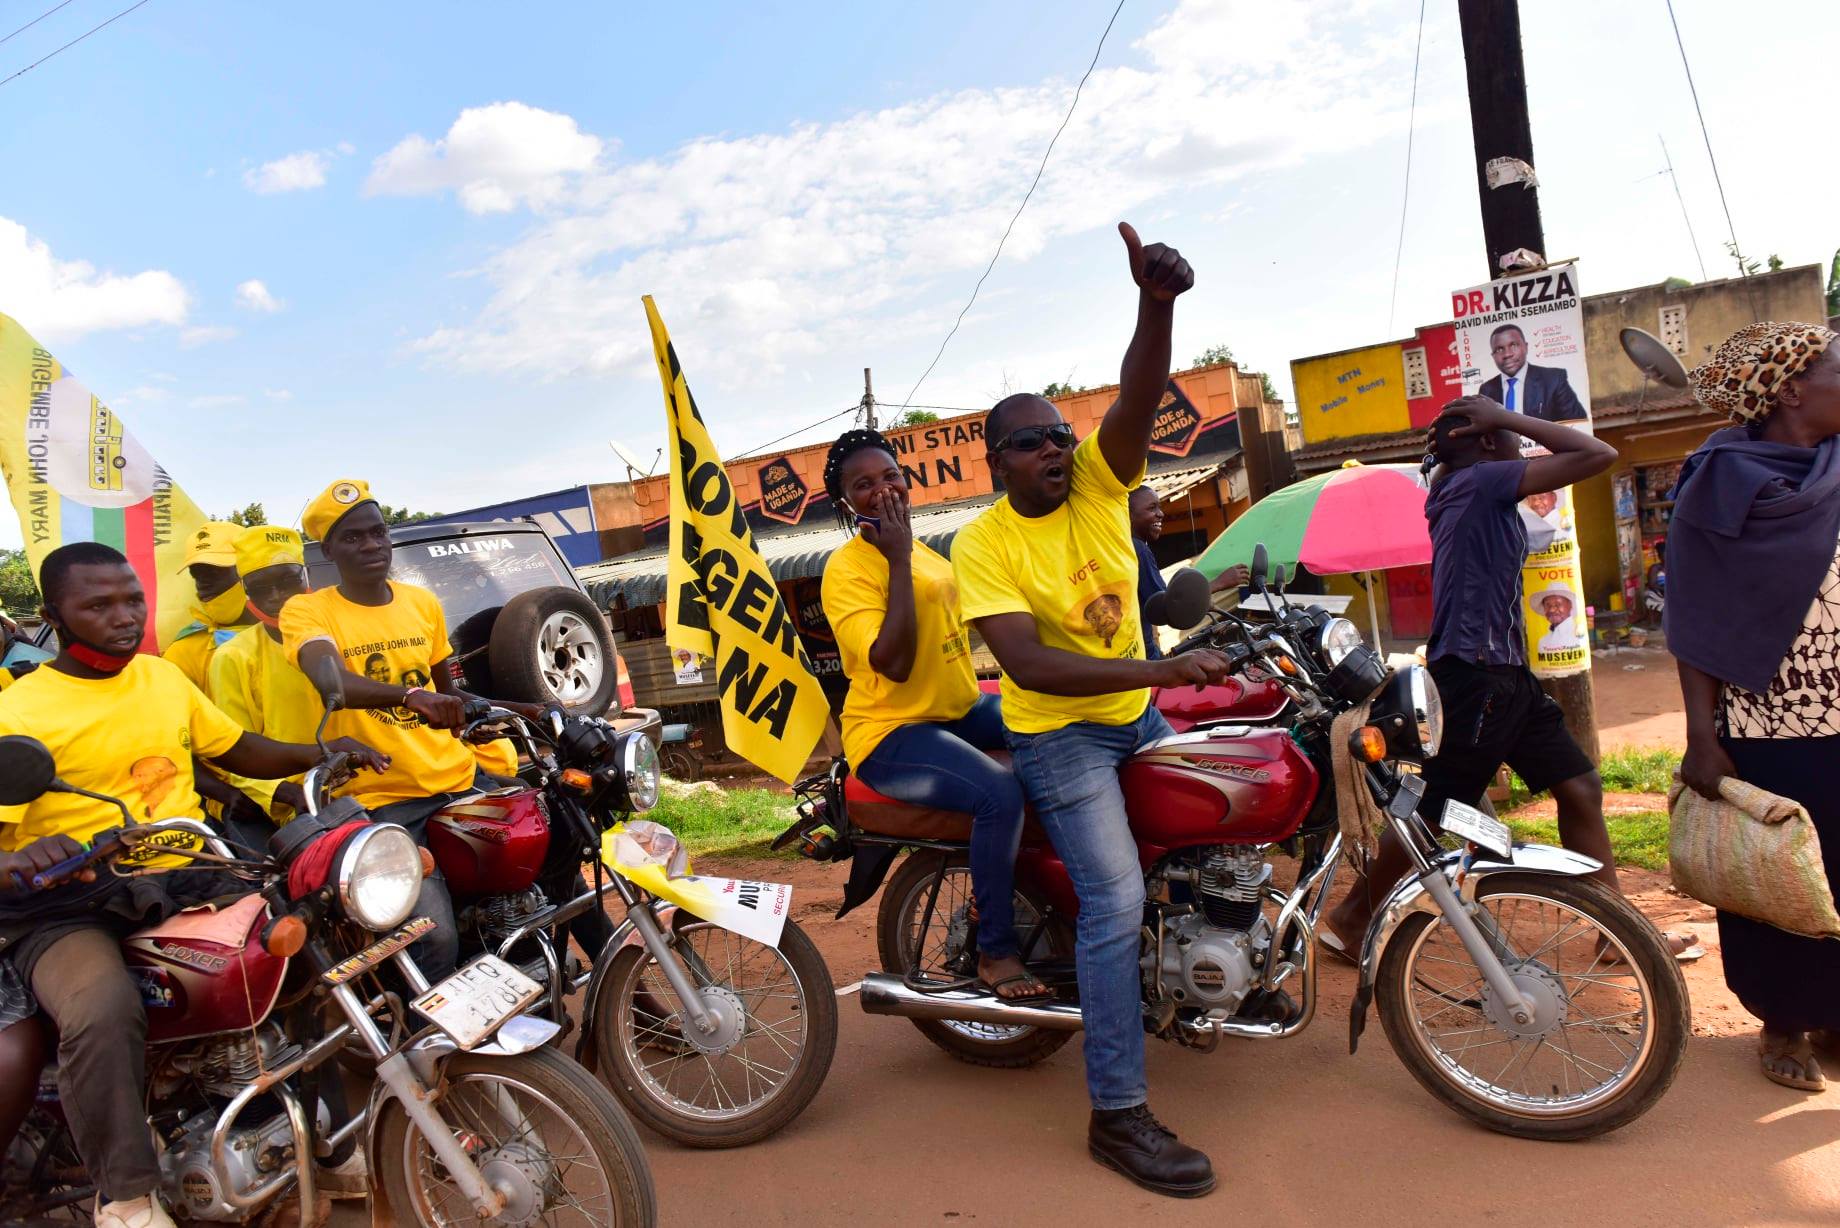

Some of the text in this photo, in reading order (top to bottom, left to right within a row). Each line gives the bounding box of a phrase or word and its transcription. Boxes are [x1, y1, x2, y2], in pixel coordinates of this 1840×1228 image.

[1452, 271, 1576, 319] DR. KIZZA
[1454, 298, 1577, 330] DAVID MARTIN SSEMAMBO
[1337, 367, 1362, 384] MTN
[1151, 414, 1197, 440] UGANDA
[1154, 410, 1176, 428] ADE
[924, 421, 985, 449] STAR
[764, 484, 789, 502] MADE
[769, 487, 805, 510] UGANDA
[265, 531, 291, 545] NRM
[427, 538, 515, 558] BALIWA
[1068, 558, 1101, 586] VOTE
[1538, 568, 1575, 581] VOTE
[343, 641, 386, 659] BUGEMBE
[387, 638, 409, 650] JOHN
[1537, 649, 1586, 662] MUSEVENI
[813, 658, 842, 675] 3,20
[1196, 758, 1272, 781] BOXER
[723, 879, 736, 894] You
[160, 943, 229, 970] BOXER
